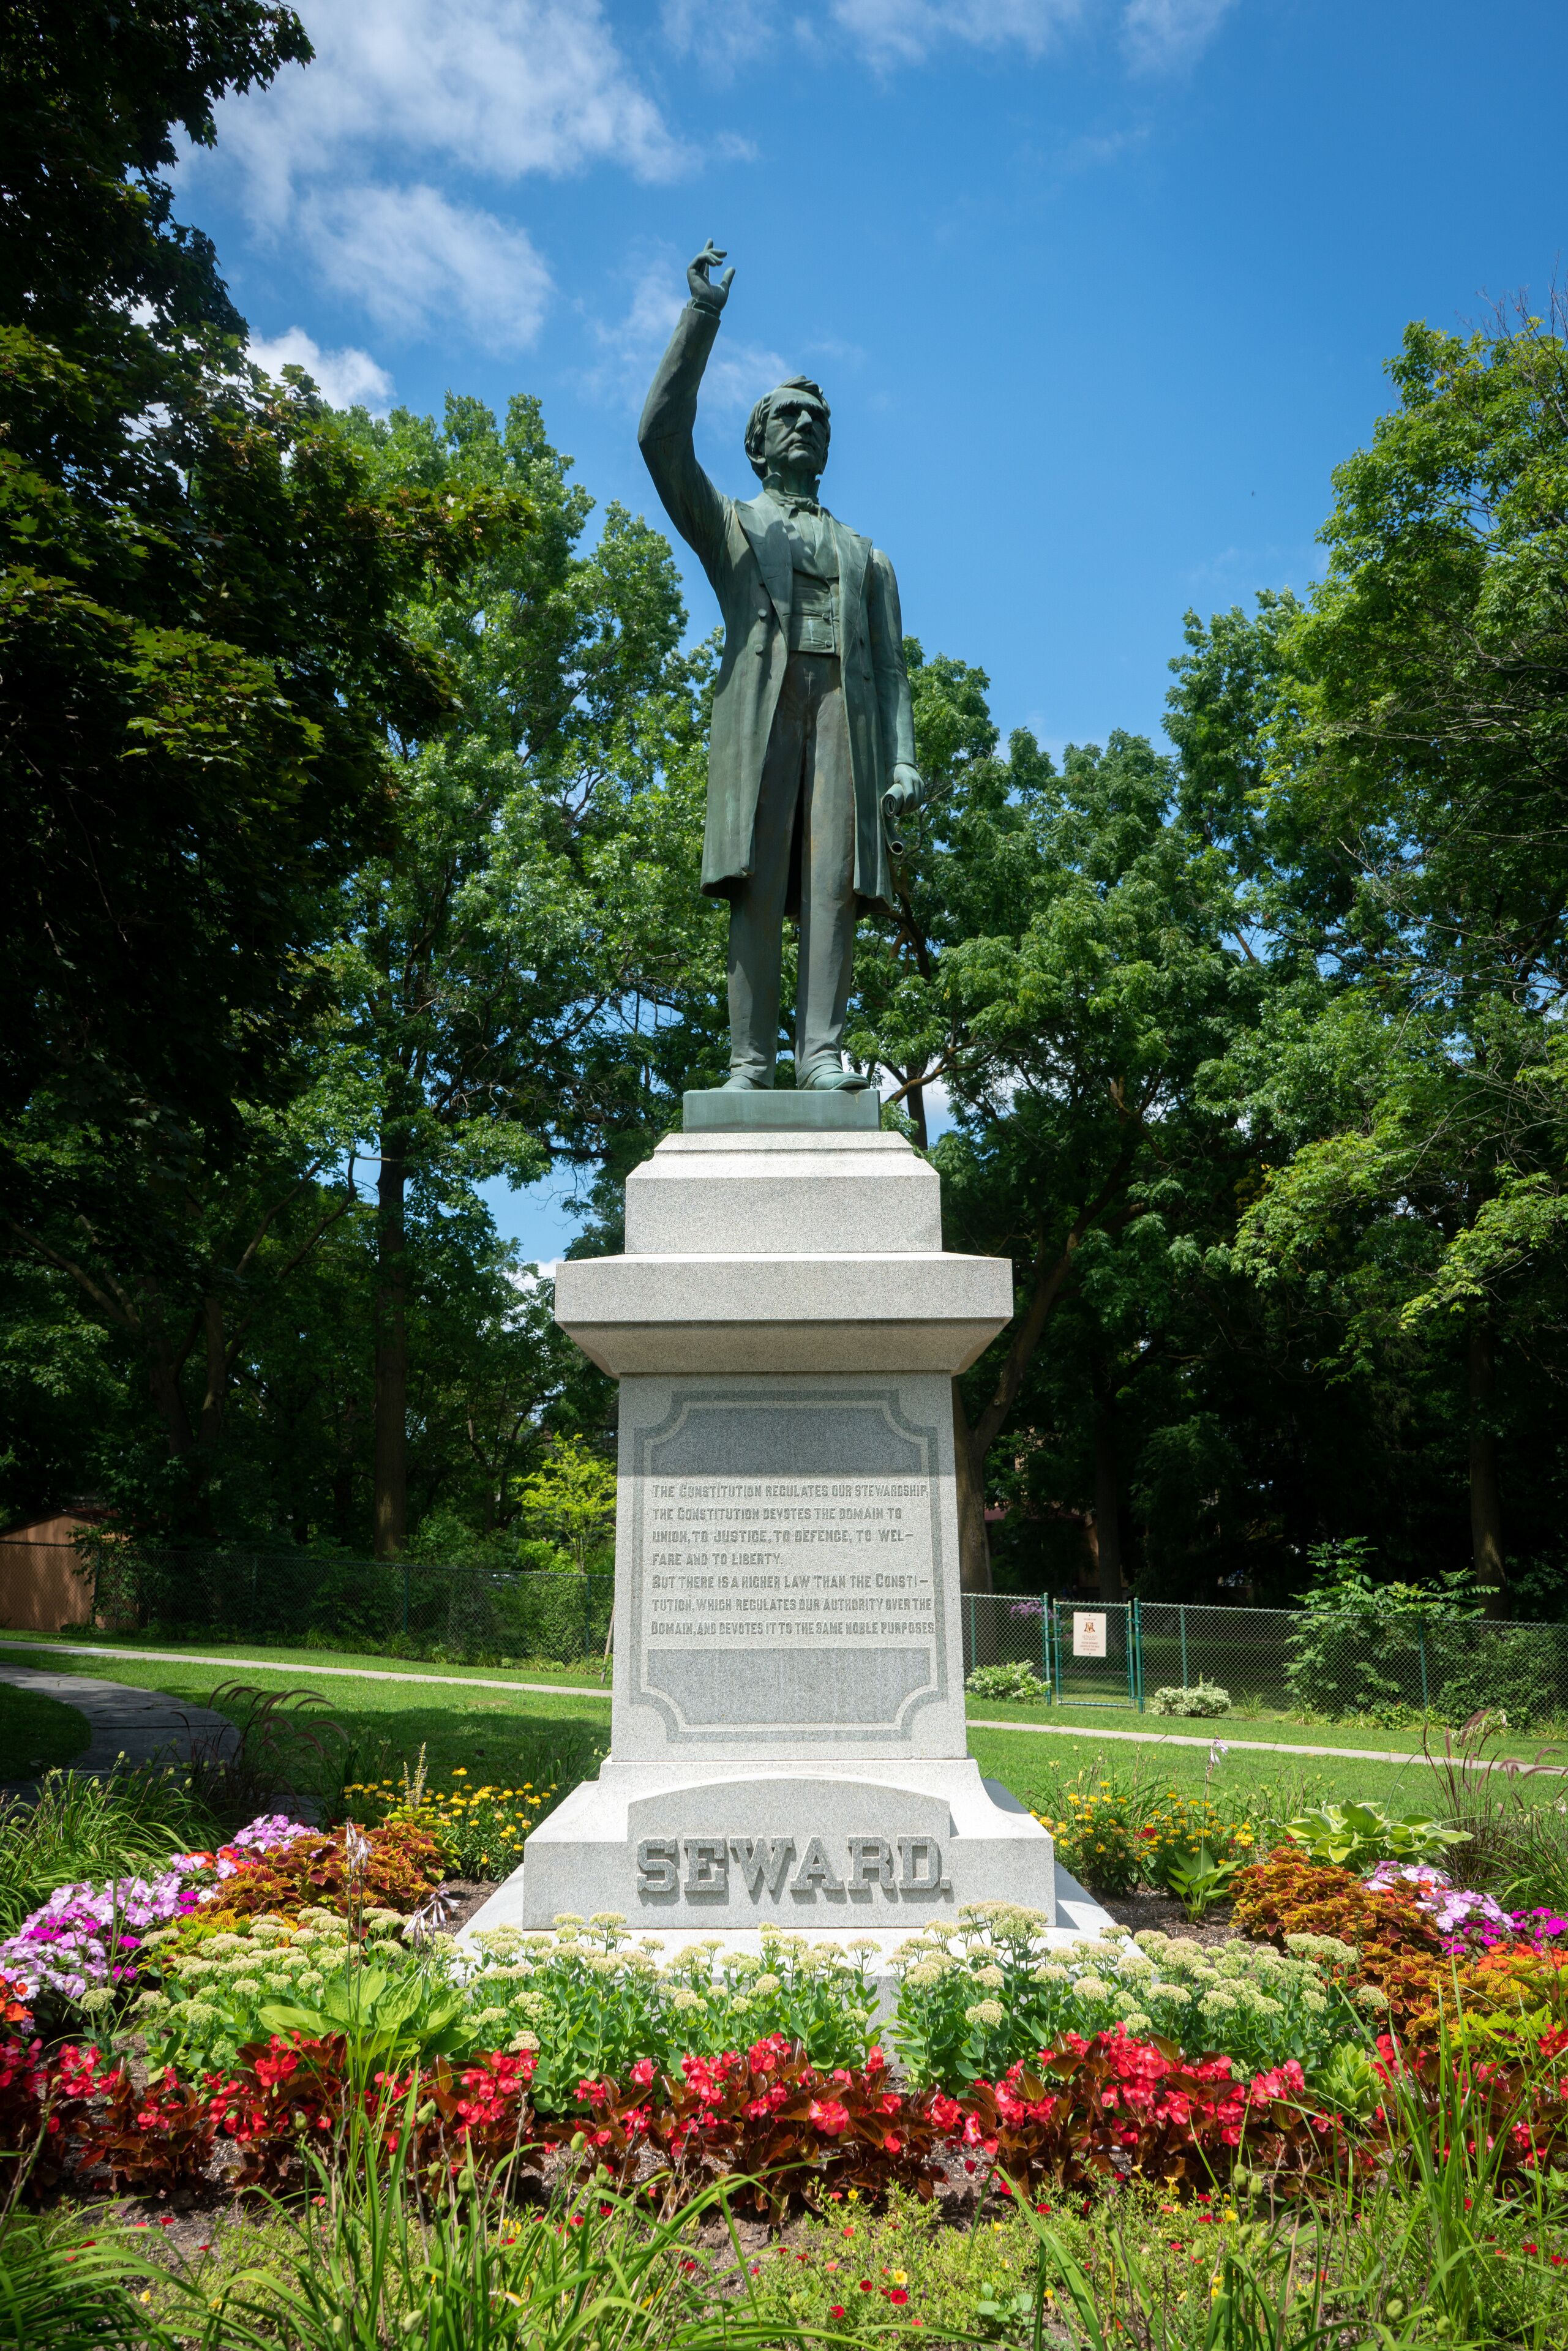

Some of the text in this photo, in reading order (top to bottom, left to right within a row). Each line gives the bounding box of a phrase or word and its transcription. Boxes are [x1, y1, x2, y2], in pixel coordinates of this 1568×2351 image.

[653, 1484, 675, 1498] THE
[679, 1483, 762, 1498] CONSTITUTION
[765, 1483, 828, 1497] REGULATES
[831, 1484, 852, 1497] OUR
[653, 1506, 902, 1520] THE CONSTITUTION DEVOTES THE DOMAIN TO
[653, 1529, 691, 1544] UNION,
[692, 1530, 708, 1543] TO
[713, 1529, 771, 1544] JUSTICE,
[773, 1529, 790, 1542] TO
[795, 1529, 852, 1543] DEFENCE,
[856, 1529, 872, 1542] TO
[652, 1553, 784, 1565] FARE AND TO LIBERTY.
[652, 1574, 675, 1589] BUT
[678, 1575, 714, 1588] THERE
[718, 1575, 729, 1588] IS
[730, 1575, 739, 1588] A
[741, 1575, 780, 1588] HIGHER
[784, 1575, 810, 1588] LAW
[814, 1575, 846, 1588] THAN
[849, 1575, 871, 1588] THE
[652, 1598, 931, 1612] TUTION, WHICH REGULATES OUR AUTHORITY OVER THE
[719, 1622, 763, 1635] DEVOTES
[766, 1622, 776, 1635] IT
[778, 1622, 792, 1635] TO
[796, 1622, 814, 1635] THE
[816, 1622, 842, 1635] SAME
[846, 1622, 878, 1634] NOBLE
[880, 1622, 936, 1635] PURPOSES.
[637, 1835, 951, 1892] SEWARD.
